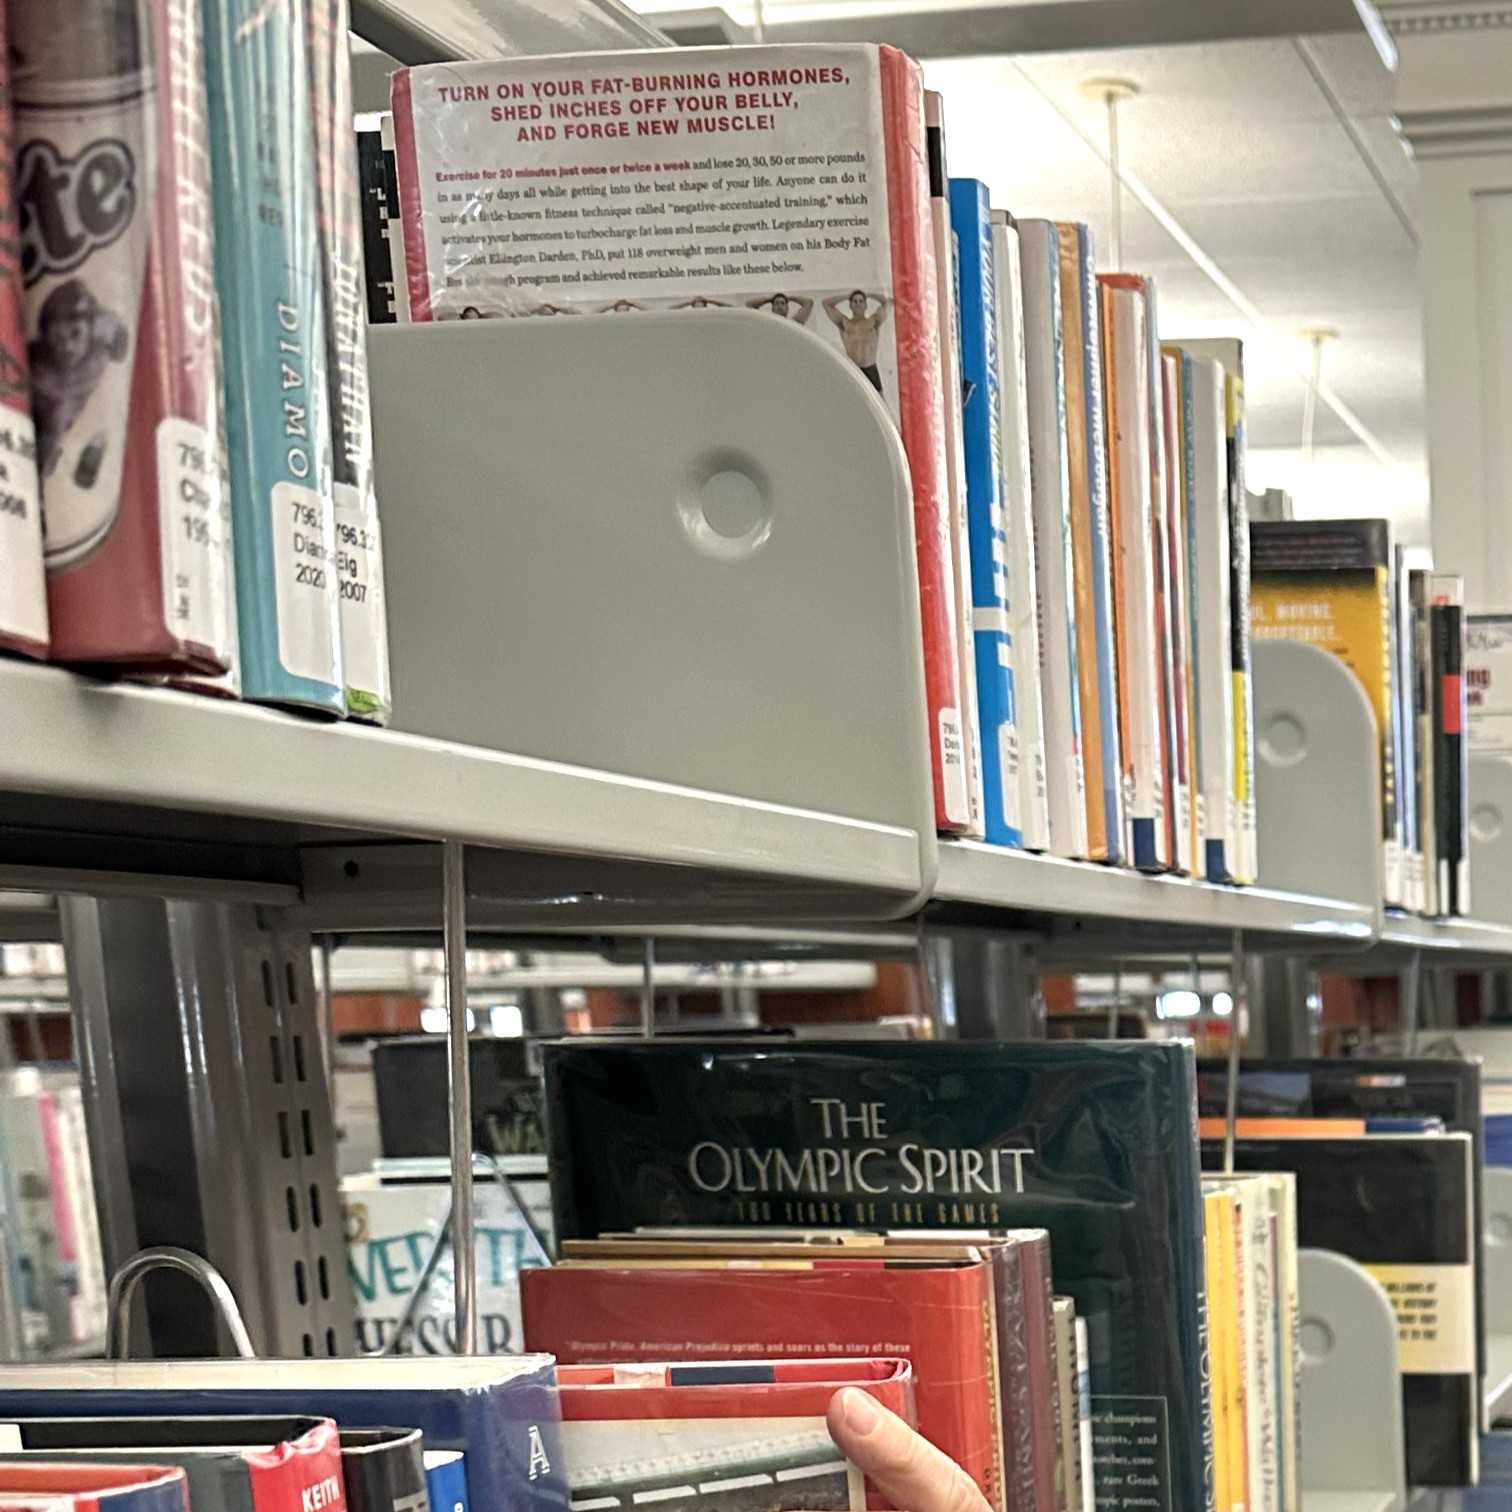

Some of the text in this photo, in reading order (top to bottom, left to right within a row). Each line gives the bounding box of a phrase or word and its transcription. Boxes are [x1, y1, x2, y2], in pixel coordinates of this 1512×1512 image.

[438, 67, 851, 102] TURN ON YOUR FAT-BURNING HORMONES,
[491, 92, 799, 121] SHED INCHES OFF YOUR BELLY,
[517, 114, 776, 142] AND FORGE NEW MUSCLE!
[436, 170, 480, 182] Exercise
[482, 169, 497, 180] for
[499, 168, 513, 179] 20
[515, 166, 557, 178] minutes
[559, 165, 579, 178] just
[581, 165, 607, 175] once
[610, 166, 621, 174] or
[623, 163, 652, 174] twice
[663, 160, 691, 171] week
[693, 158, 712, 169] and
[713, 157, 735, 168] lose
[735, 156, 751, 169] 20,
[753, 155, 769, 168] 30,
[770, 155, 783, 166] 50
[785, 156, 796, 165] or
[798, 155, 825, 165] more
[827, 152, 866, 166] pounds
[811, 1098, 889, 1139] THE
[689, 1141, 1035, 1194] OLYMPIC SPIRIT
[785, 1202, 843, 1223] YEARS
[856, 1202, 877, 1223] OF
[892, 1202, 925, 1223] THE
[938, 1203, 1000, 1224] GAMES
[528, 1425, 550, 1480] A
